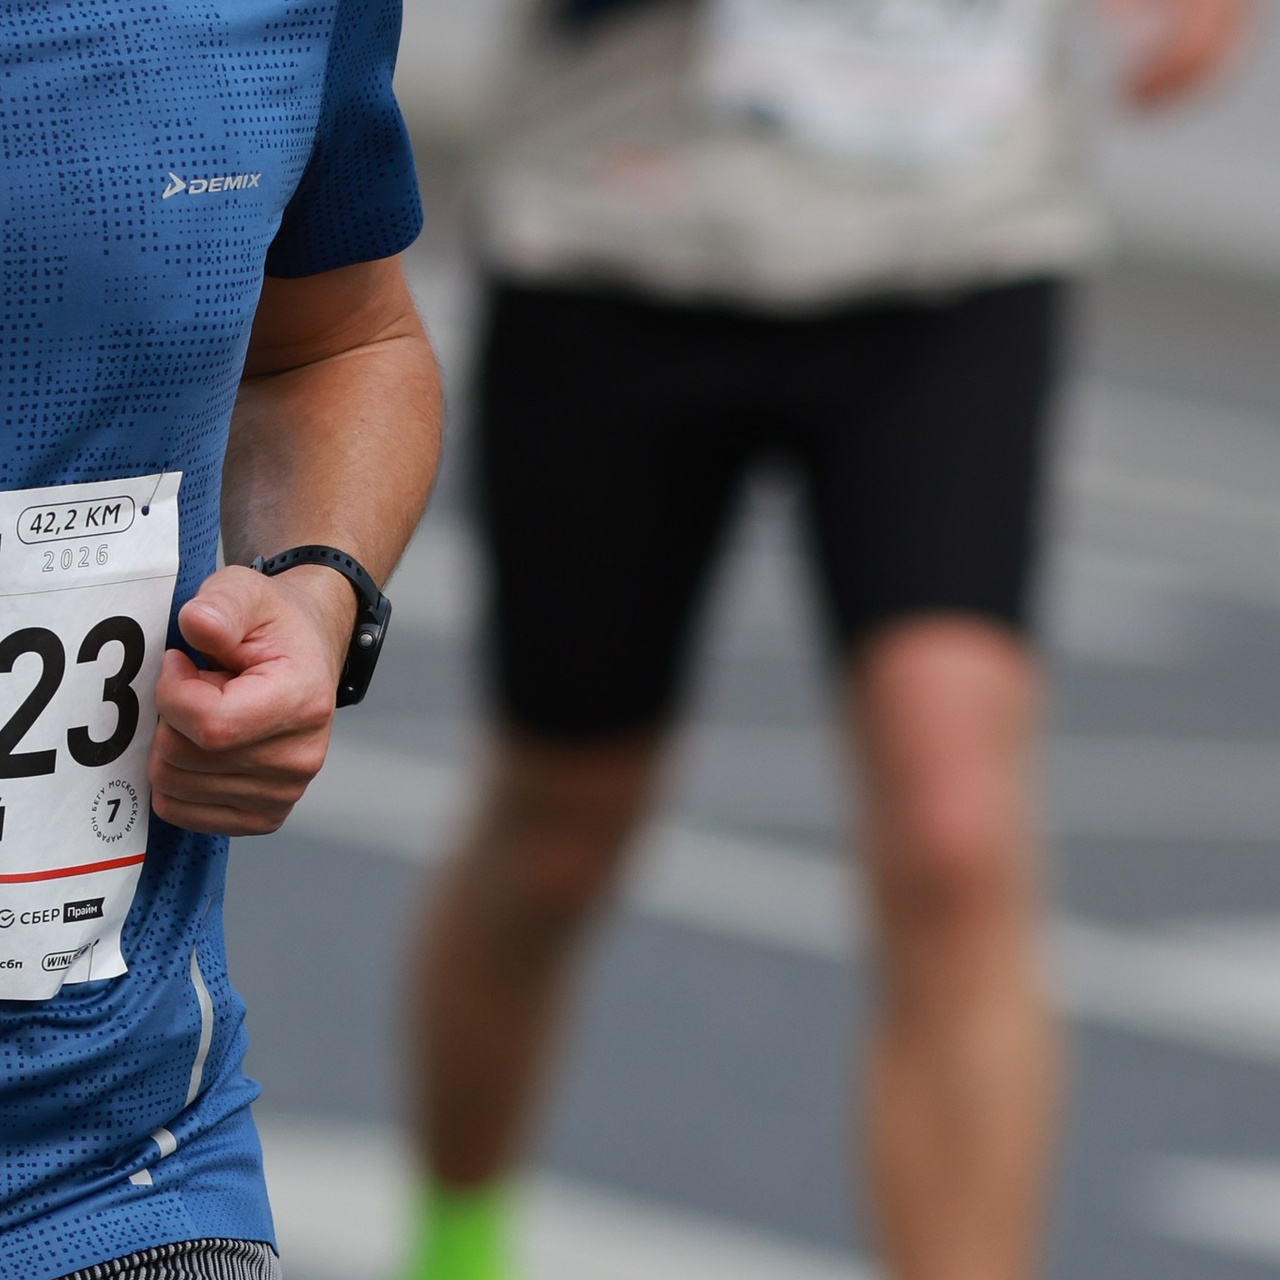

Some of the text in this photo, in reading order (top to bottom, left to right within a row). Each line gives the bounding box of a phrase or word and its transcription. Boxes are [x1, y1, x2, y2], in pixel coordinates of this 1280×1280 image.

[188, 173, 261, 195] DEMIX
[30, 503, 122, 536] 42,2 КМ
[42, 544, 109, 572] 2026
[107, 798, 121, 823] 7
[20, 904, 98, 925] СБЕР Прайм
